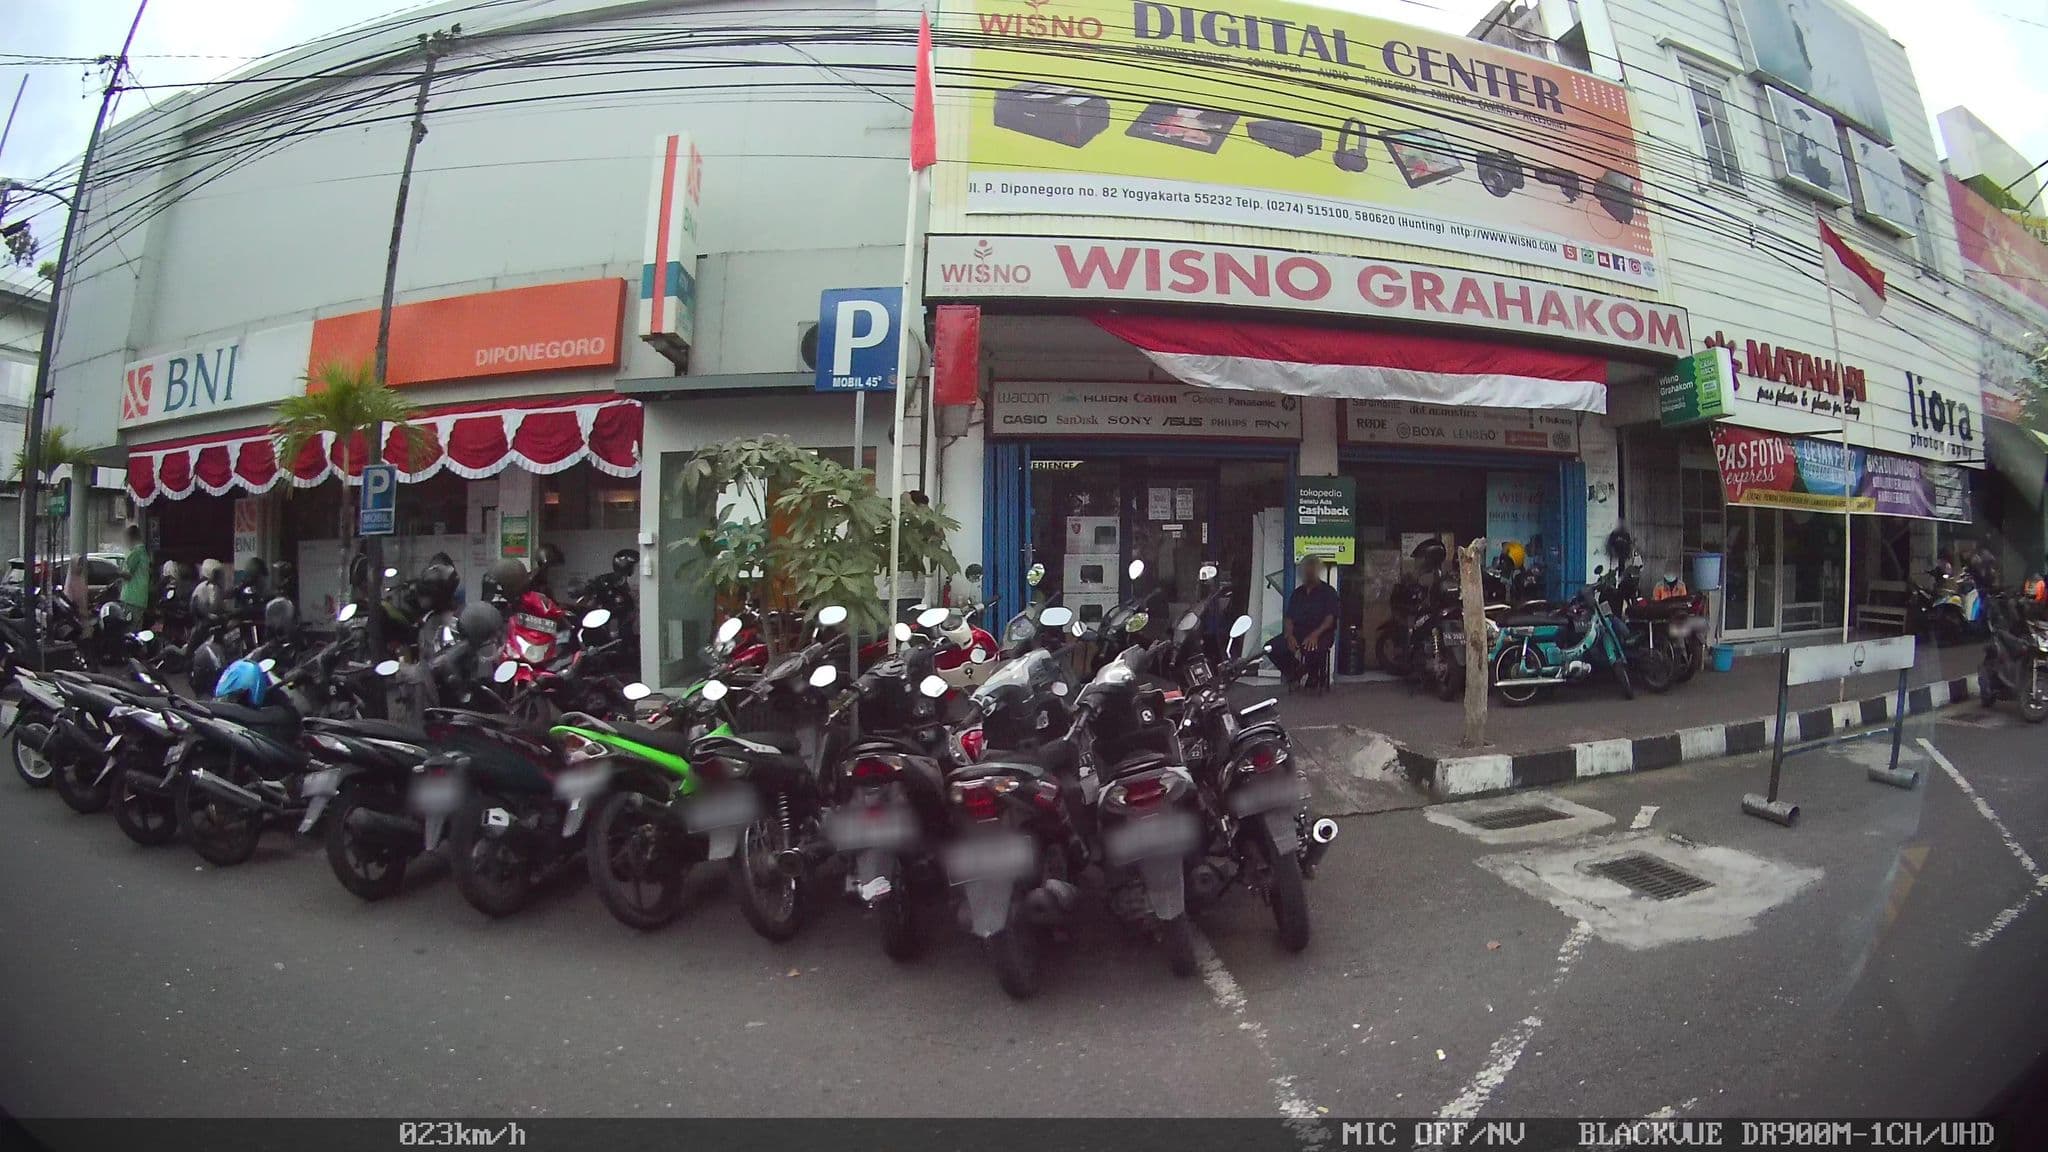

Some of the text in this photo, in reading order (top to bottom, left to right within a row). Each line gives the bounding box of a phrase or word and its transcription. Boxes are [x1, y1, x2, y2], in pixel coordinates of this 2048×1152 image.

[979, 12, 1104, 40] WISNO
[1134, 2, 1564, 115] DIGITAL CENTER
[985, 183, 997, 193] P.
[1001, 183, 1074, 198] Diponegoro
[1079, 186, 1098, 197] no.
[1102, 187, 1118, 198] 82
[1122, 188, 1190, 203] Yogyakarta
[1194, 193, 1232, 207] 55232
[1236, 196, 1263, 211] Telp.
[1267, 199, 1303, 214] (0274)
[1307, 204, 1352, 221] 515100,
[1355, 210, 1395, 225] 580620
[1399, 216, 1445, 234] (Hunting)
[941, 264, 1031, 283] WISNO
[1054, 244, 1685, 350] WISNO GRAHAKOM
[475, 336, 606, 367] DIPONEGORO
[833, 300, 890, 376] P
[164, 344, 239, 412] BNI
[832, 377, 864, 388] MOBIL
[1133, 392, 1177, 404] Canon
[1906, 371, 1973, 440] liora
[1003, 414, 1047, 425] CASIO
[1056, 415, 1098, 425] SanDisk
[1108, 415, 1152, 425] SONY
[1162, 416, 1203, 427] ASUS
[1412, 426, 1445, 437] BOYA
[1717, 437, 1785, 470] PAS FOTO
[368, 469, 390, 509] P
[1300, 488, 1342, 498] tokopedia
[1726, 467, 1776, 496] express
[1298, 505, 1349, 516] Cashback
[235, 536, 256, 552] BNI
